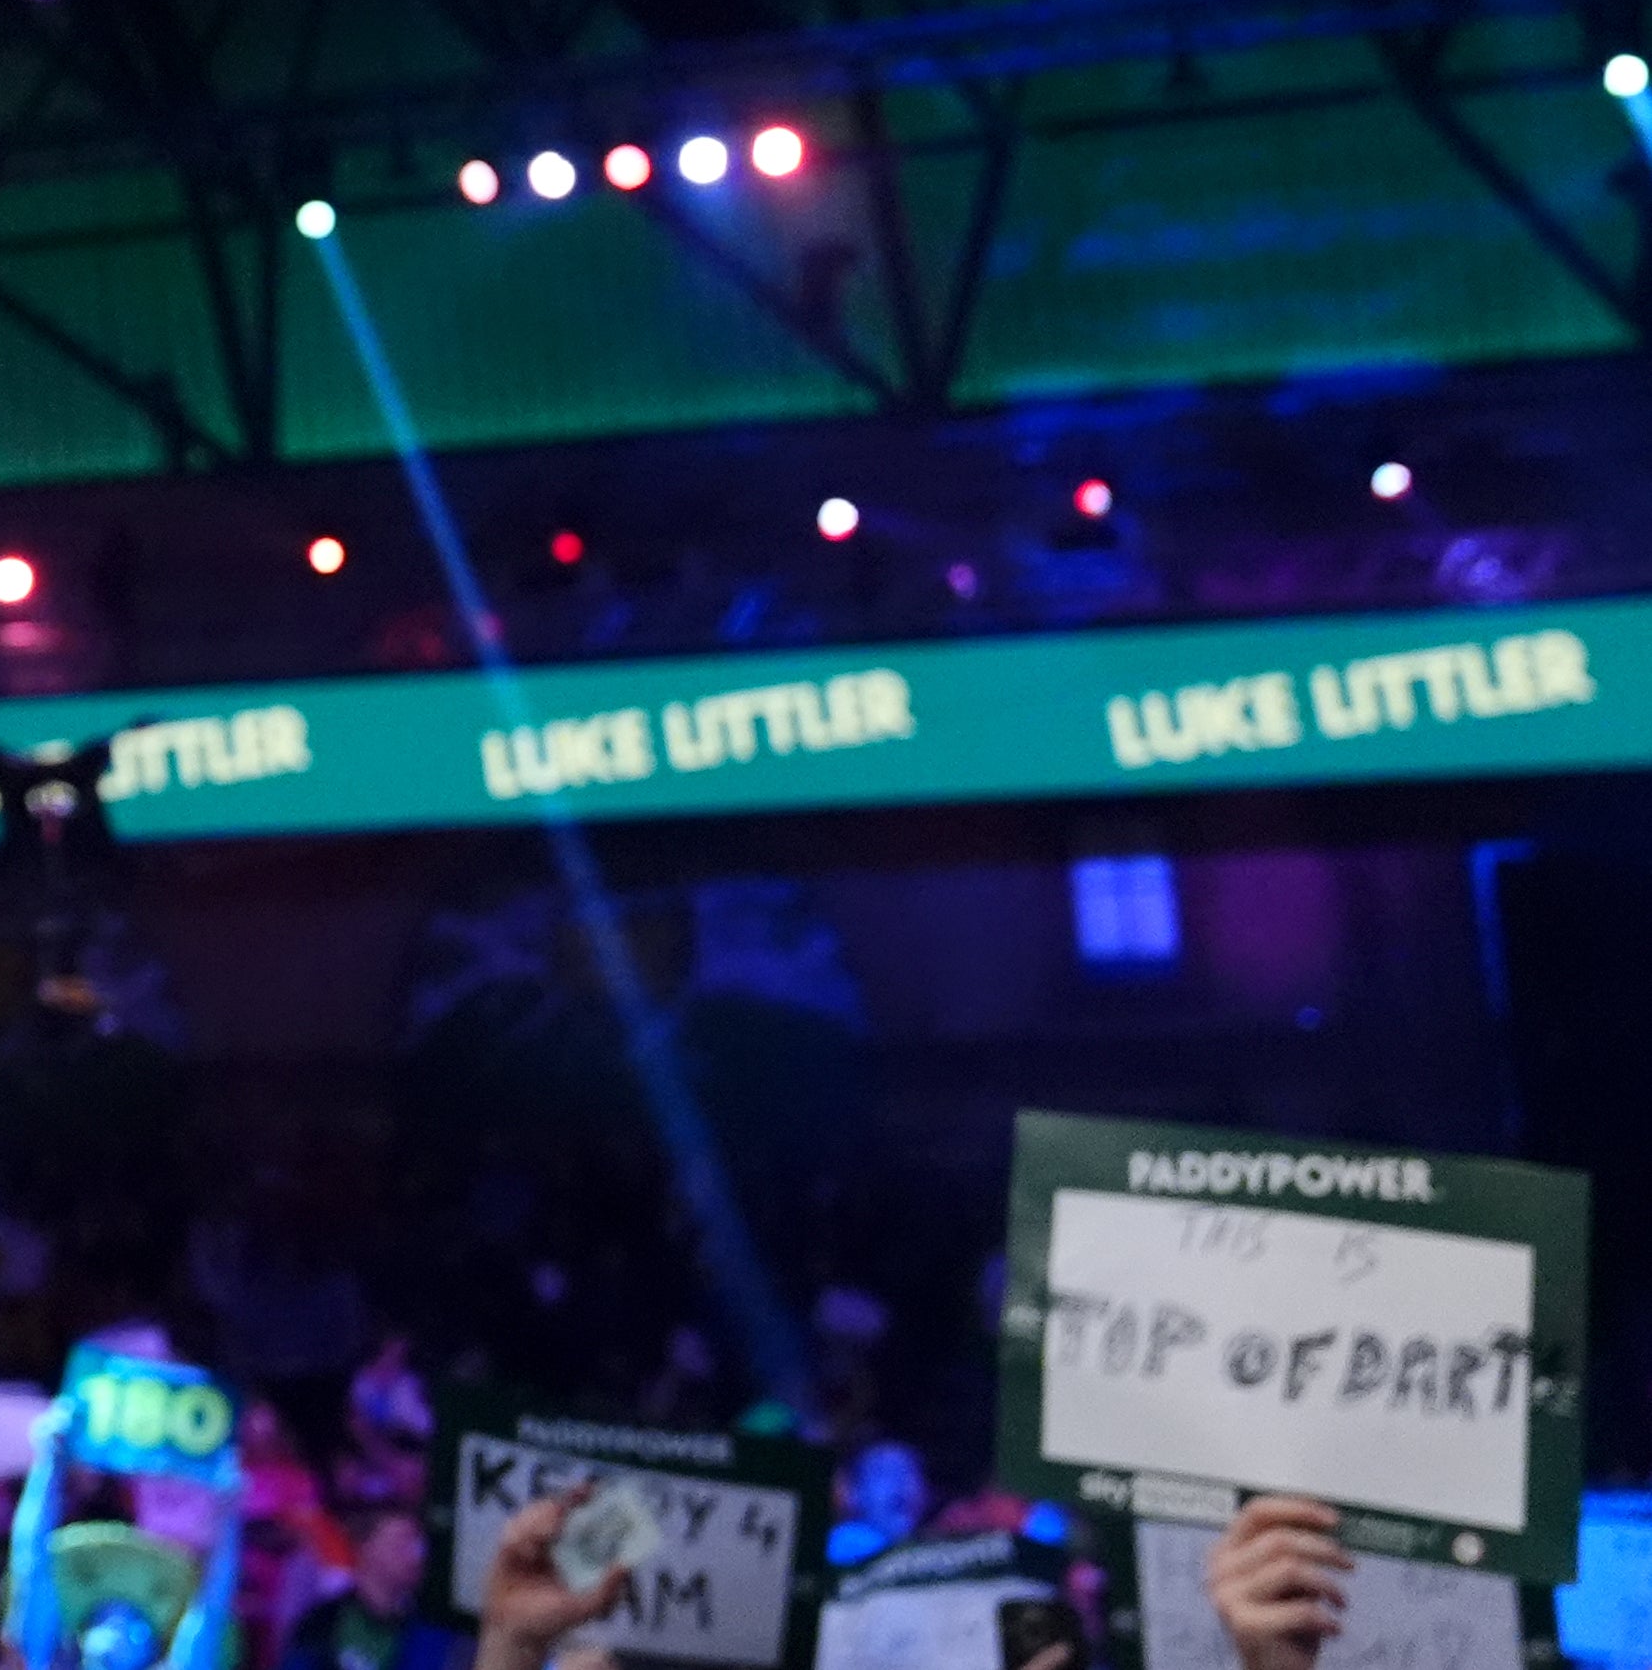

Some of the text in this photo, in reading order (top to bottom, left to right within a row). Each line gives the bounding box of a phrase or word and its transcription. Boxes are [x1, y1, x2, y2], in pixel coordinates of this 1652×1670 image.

[480, 667, 916, 800] LUKE LITTLER
[1107, 629, 1594, 770] LUKE LITTLER
[74, 1372, 234, 1456] 180
